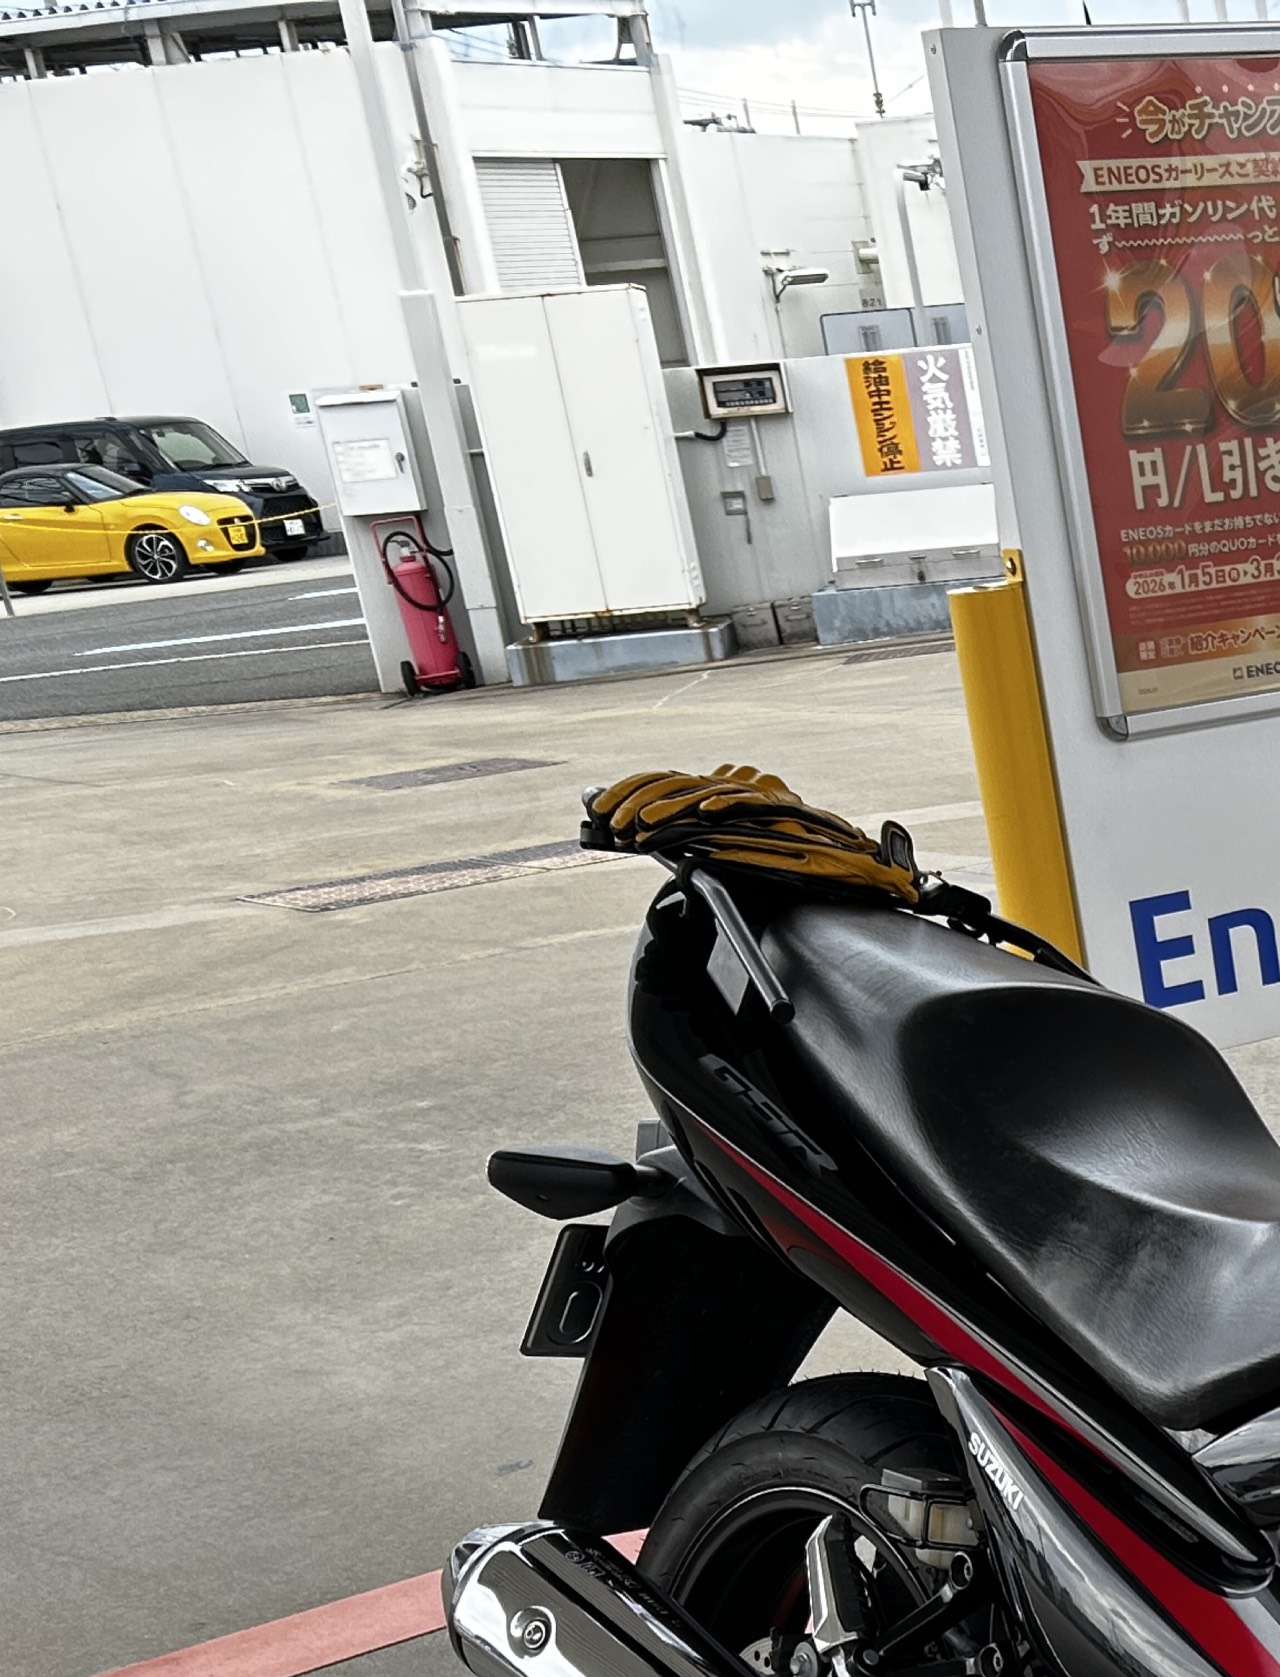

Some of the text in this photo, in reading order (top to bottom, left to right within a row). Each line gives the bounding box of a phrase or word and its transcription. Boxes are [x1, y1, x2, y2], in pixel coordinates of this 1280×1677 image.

[1089, 195, 1277, 230] 1年間ガソリン代
[862, 359, 905, 473] 給油中エンジン停止
[917, 354, 964, 467] 火気厳禁
[967, 1431, 1025, 1513] SUZUKI
